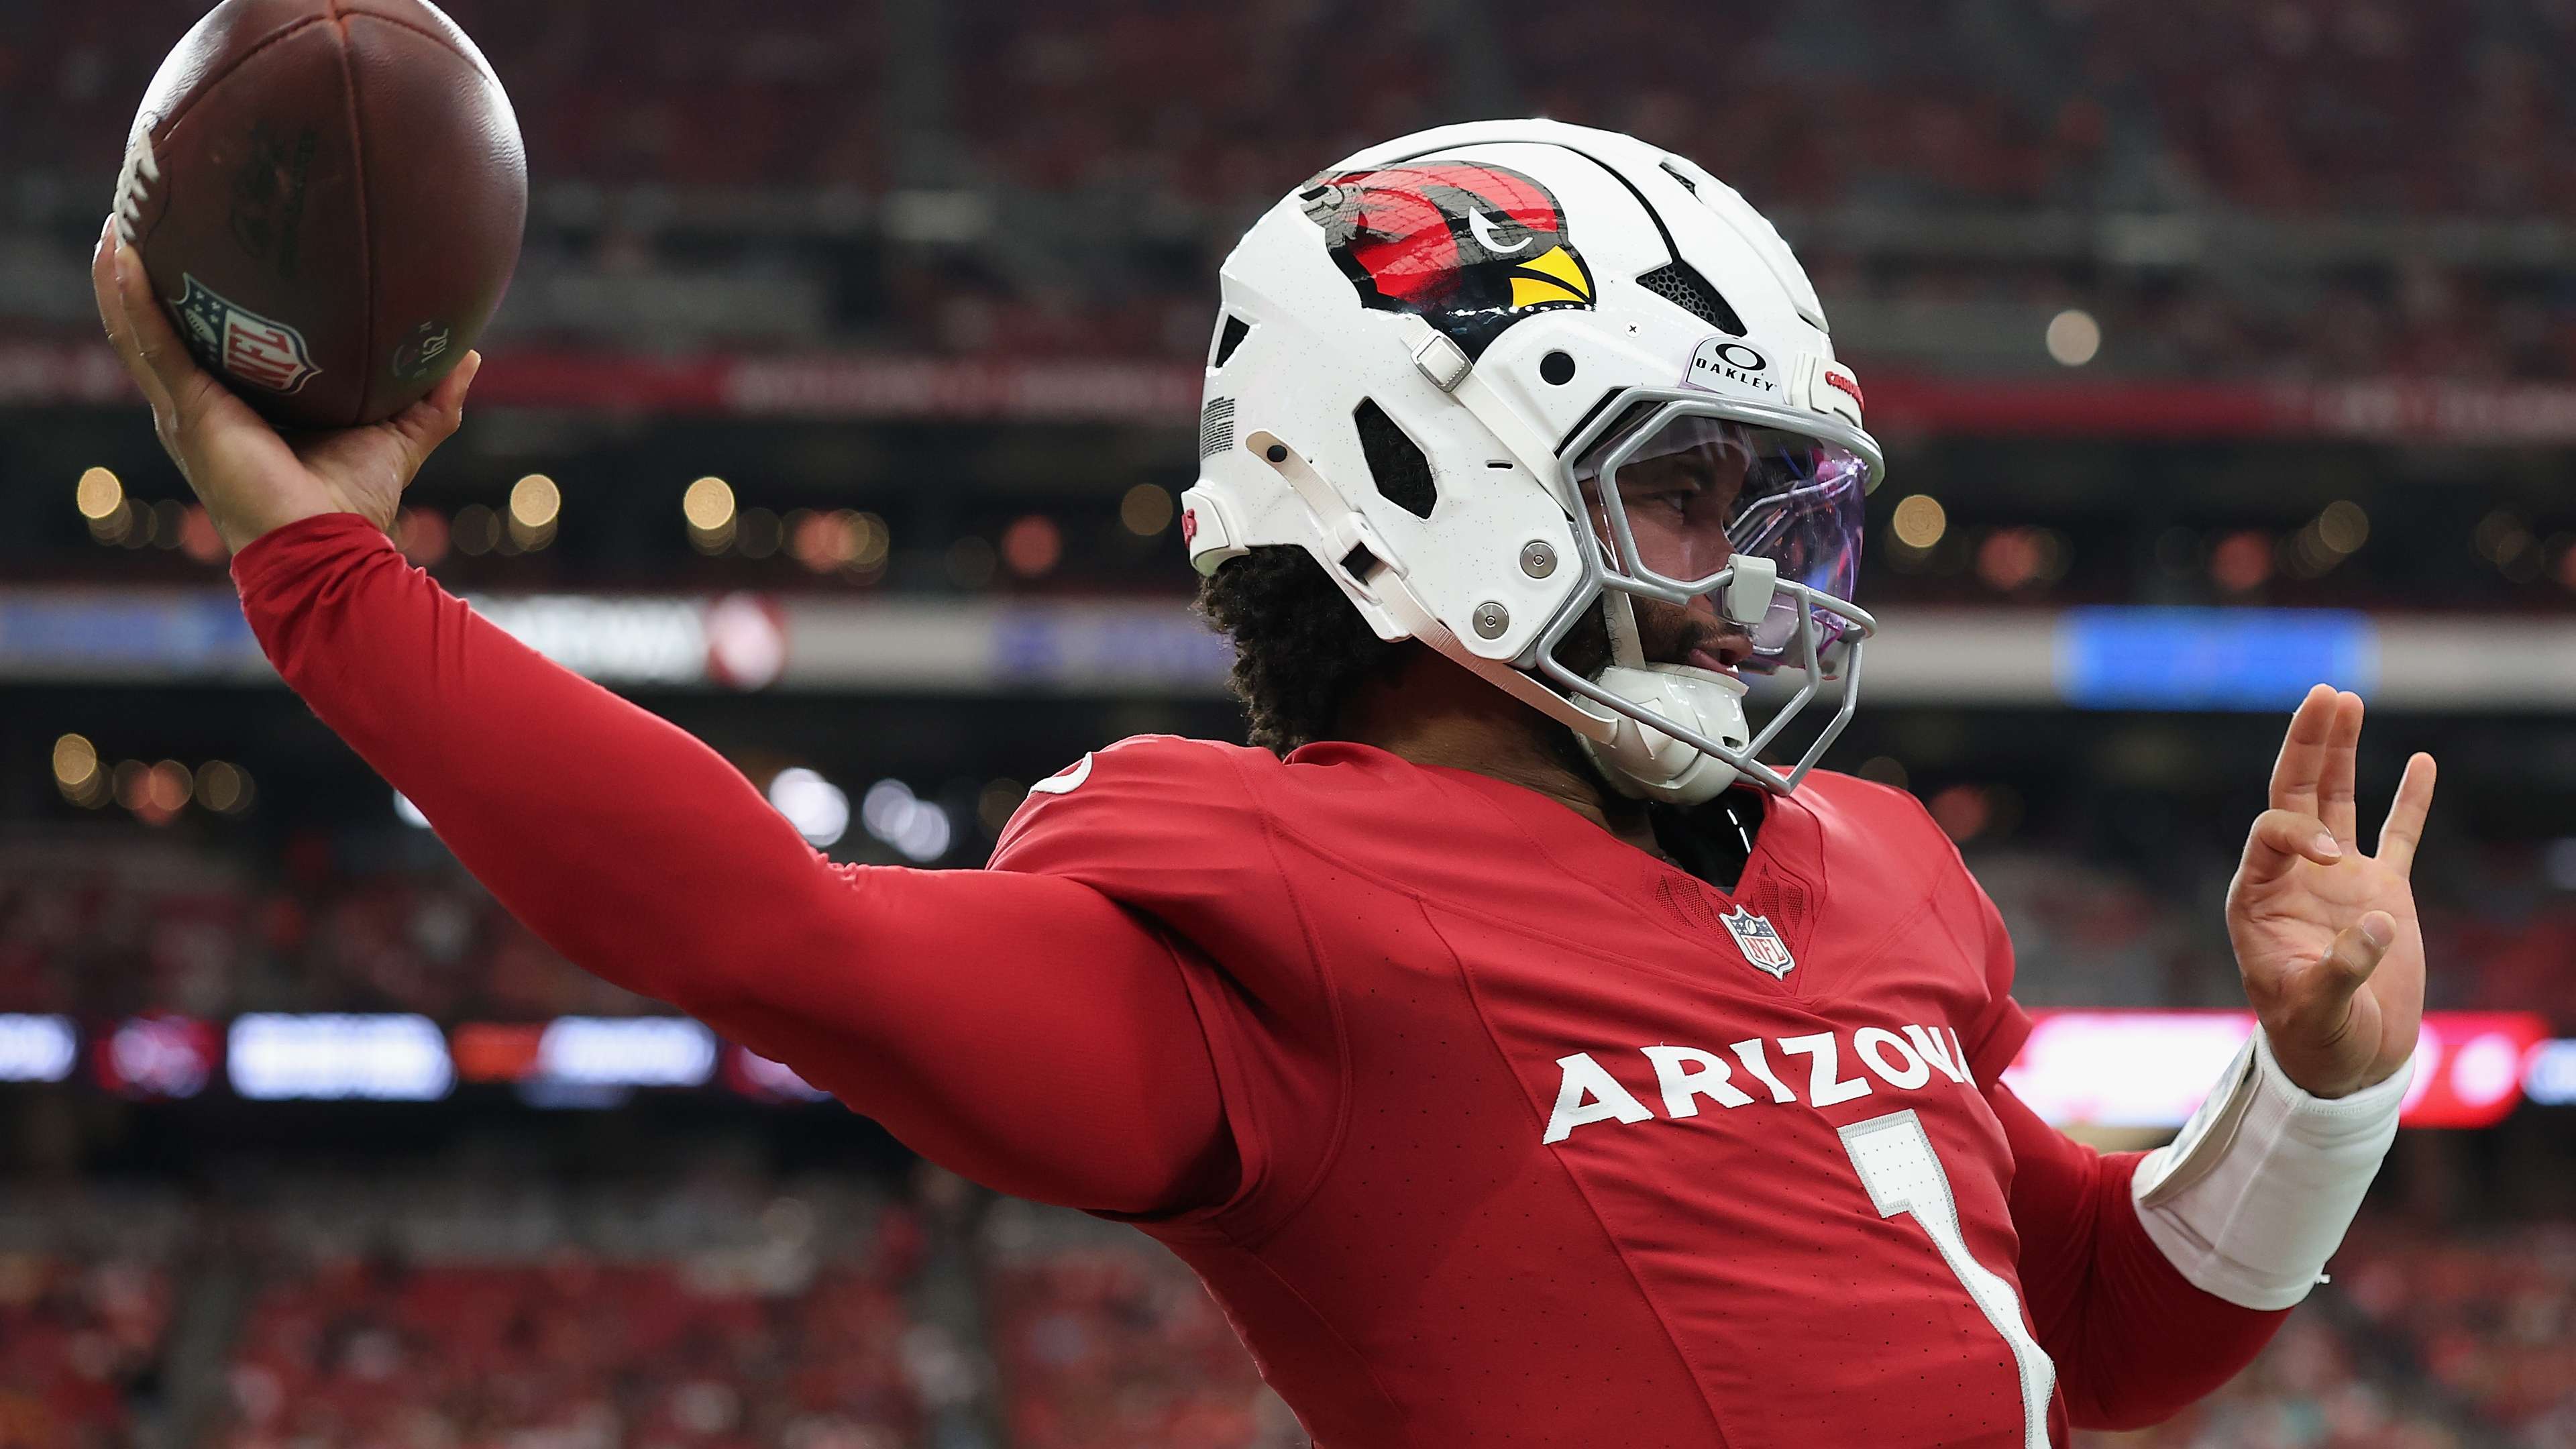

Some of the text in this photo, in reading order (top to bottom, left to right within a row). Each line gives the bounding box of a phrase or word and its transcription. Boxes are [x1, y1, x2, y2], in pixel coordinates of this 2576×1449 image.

[229, 322, 299, 388] NFL
[1695, 357, 1774, 392] OAKLEY
[1743, 936, 1786, 965] NFL
[1836, 1108, 2056, 1449] 1
